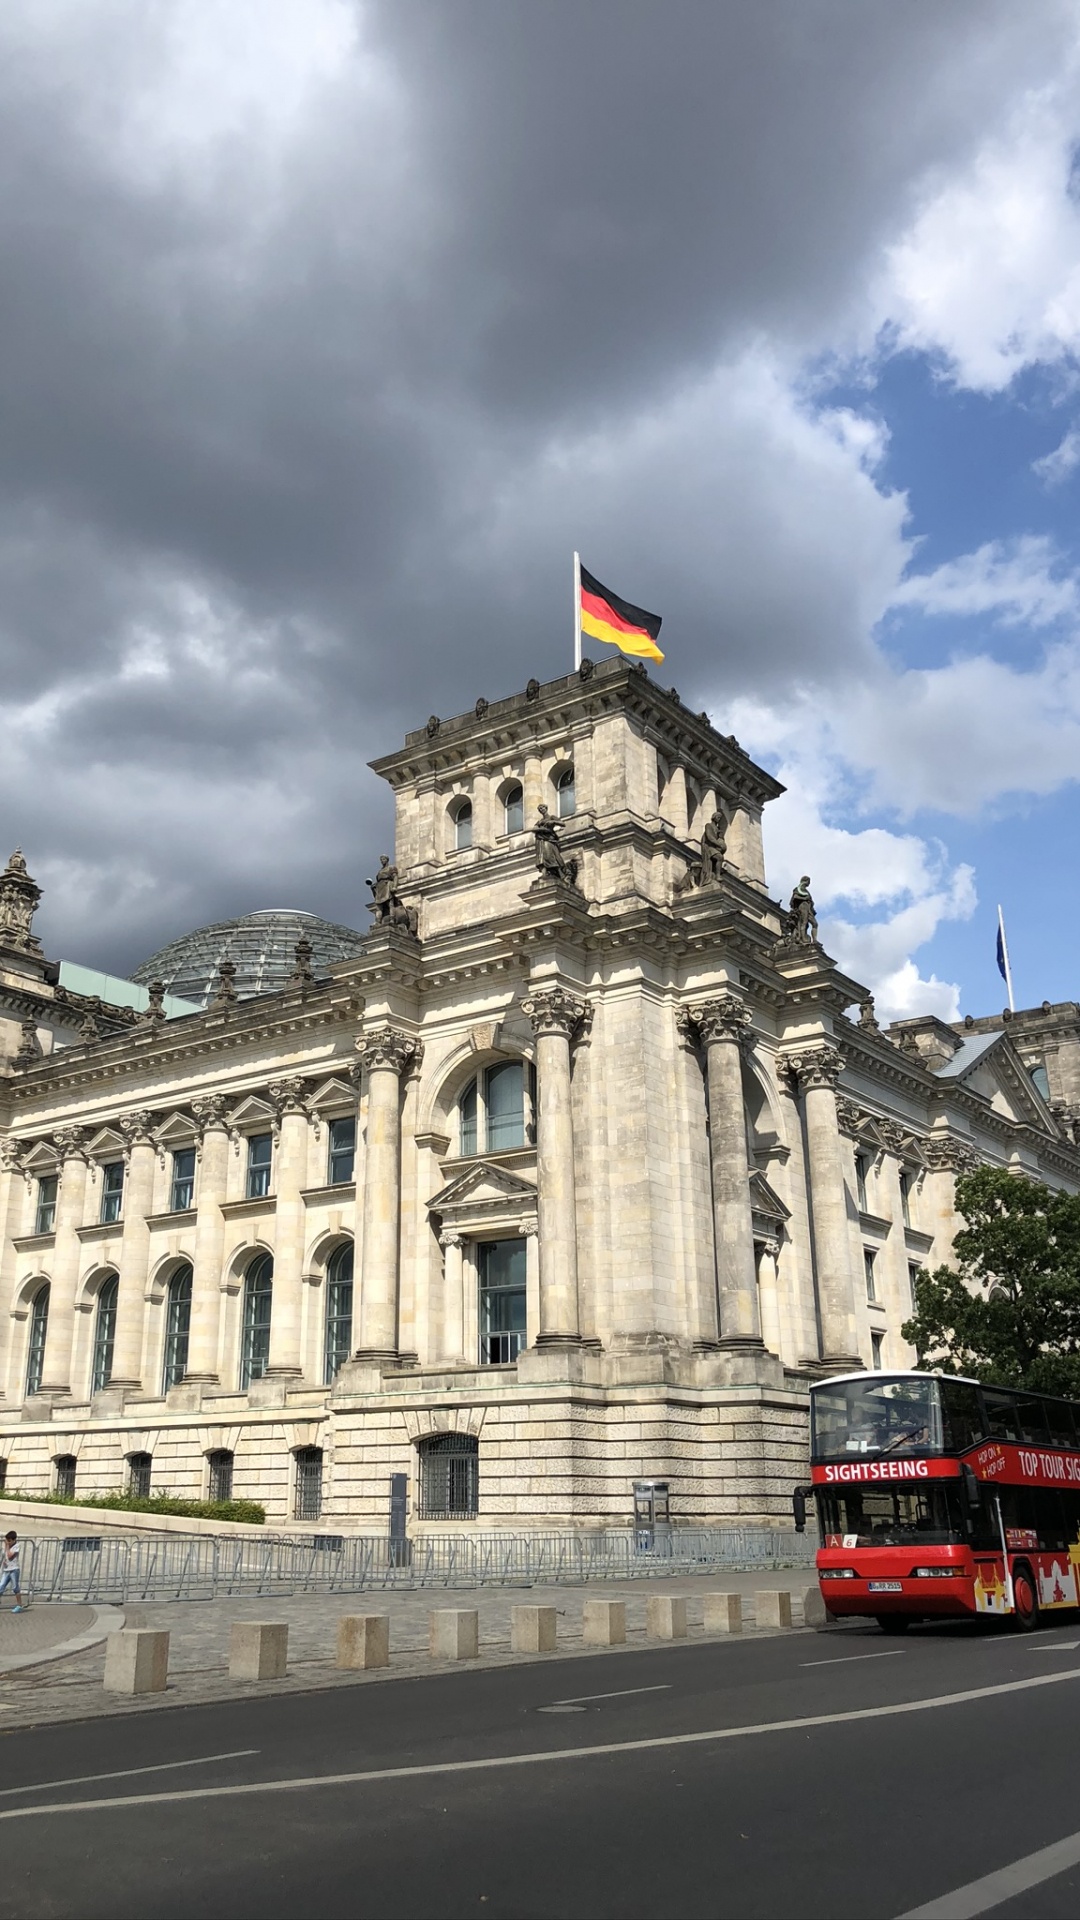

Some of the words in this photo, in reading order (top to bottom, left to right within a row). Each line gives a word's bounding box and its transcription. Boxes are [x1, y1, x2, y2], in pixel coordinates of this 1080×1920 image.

[978, 1450, 987, 1465] HOP
[988, 1446, 996, 1460] ON
[825, 1460, 928, 1481] SIGHTSEEING
[987, 1461, 996, 1477] HOP
[996, 1456, 1005, 1472] OFF
[1018, 1451, 1038, 1477] TOP
[1039, 1453, 1066, 1480] TOUR
[1066, 1456, 1080, 1482] SIG
[830, 1535, 839, 1547] A
[846, 1538, 853, 1547] 6
